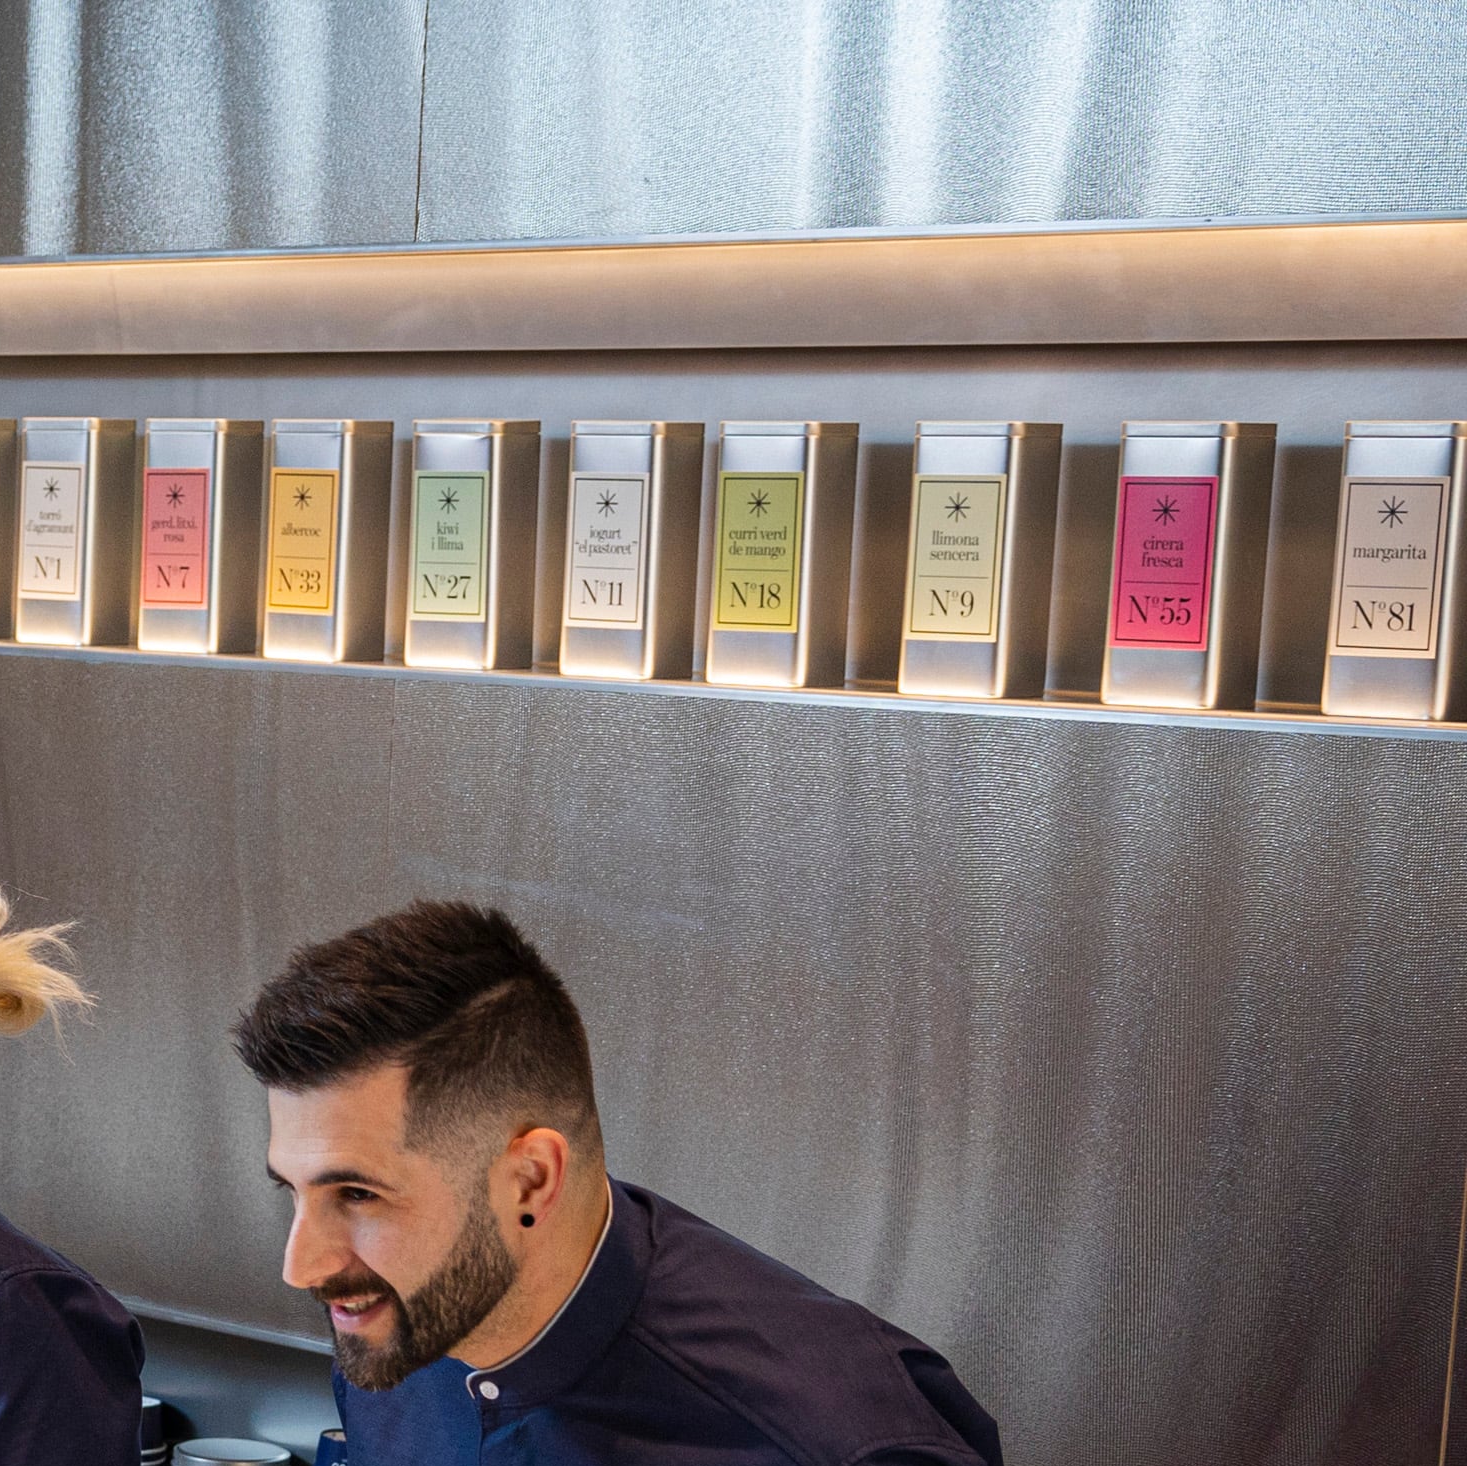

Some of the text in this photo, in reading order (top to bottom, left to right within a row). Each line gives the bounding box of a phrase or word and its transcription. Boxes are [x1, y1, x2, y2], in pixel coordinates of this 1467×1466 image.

[437, 521, 459, 535] kiwi
[589, 525, 621, 543] iogurt
[728, 526, 787, 541] curri verd
[437, 535, 464, 550] llima
[931, 530, 979, 546] llimona
[1143, 535, 1184, 551] cirera
[728, 541, 786, 560] de mango
[930, 550, 979, 561] sencera
[1352, 544, 1427, 563] margarita
[1141, 551, 1184, 568] fresca
